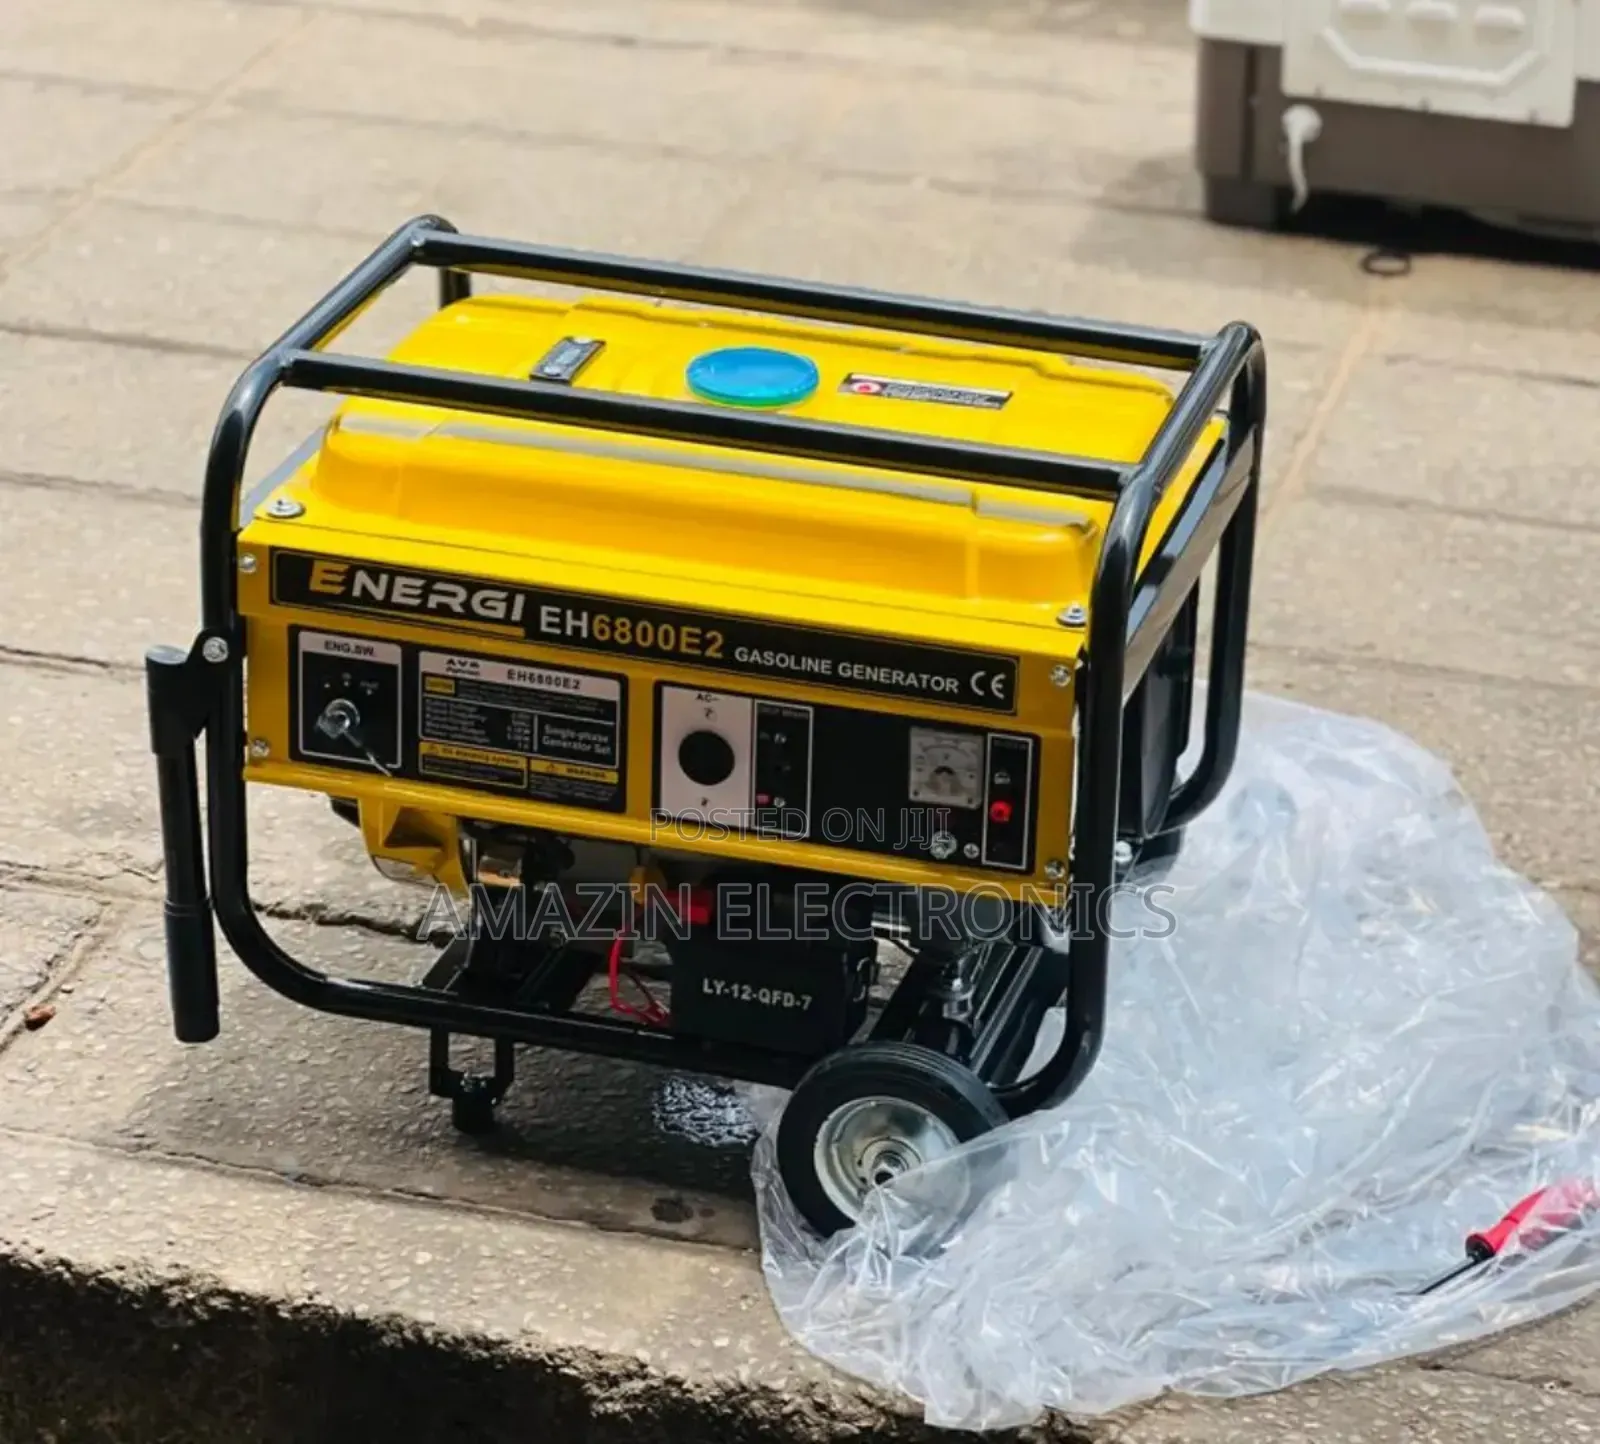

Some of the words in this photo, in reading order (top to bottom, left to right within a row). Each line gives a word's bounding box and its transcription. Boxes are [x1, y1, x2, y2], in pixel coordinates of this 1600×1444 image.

[308, 559, 526, 621] ENERGI
[539, 604, 724, 658] EH6800E2
[734, 646, 833, 676] GASOLINE
[838, 662, 959, 694] GENERATOR
[506, 668, 581, 690] EH6800E2
[542, 735, 592, 752] Generator
